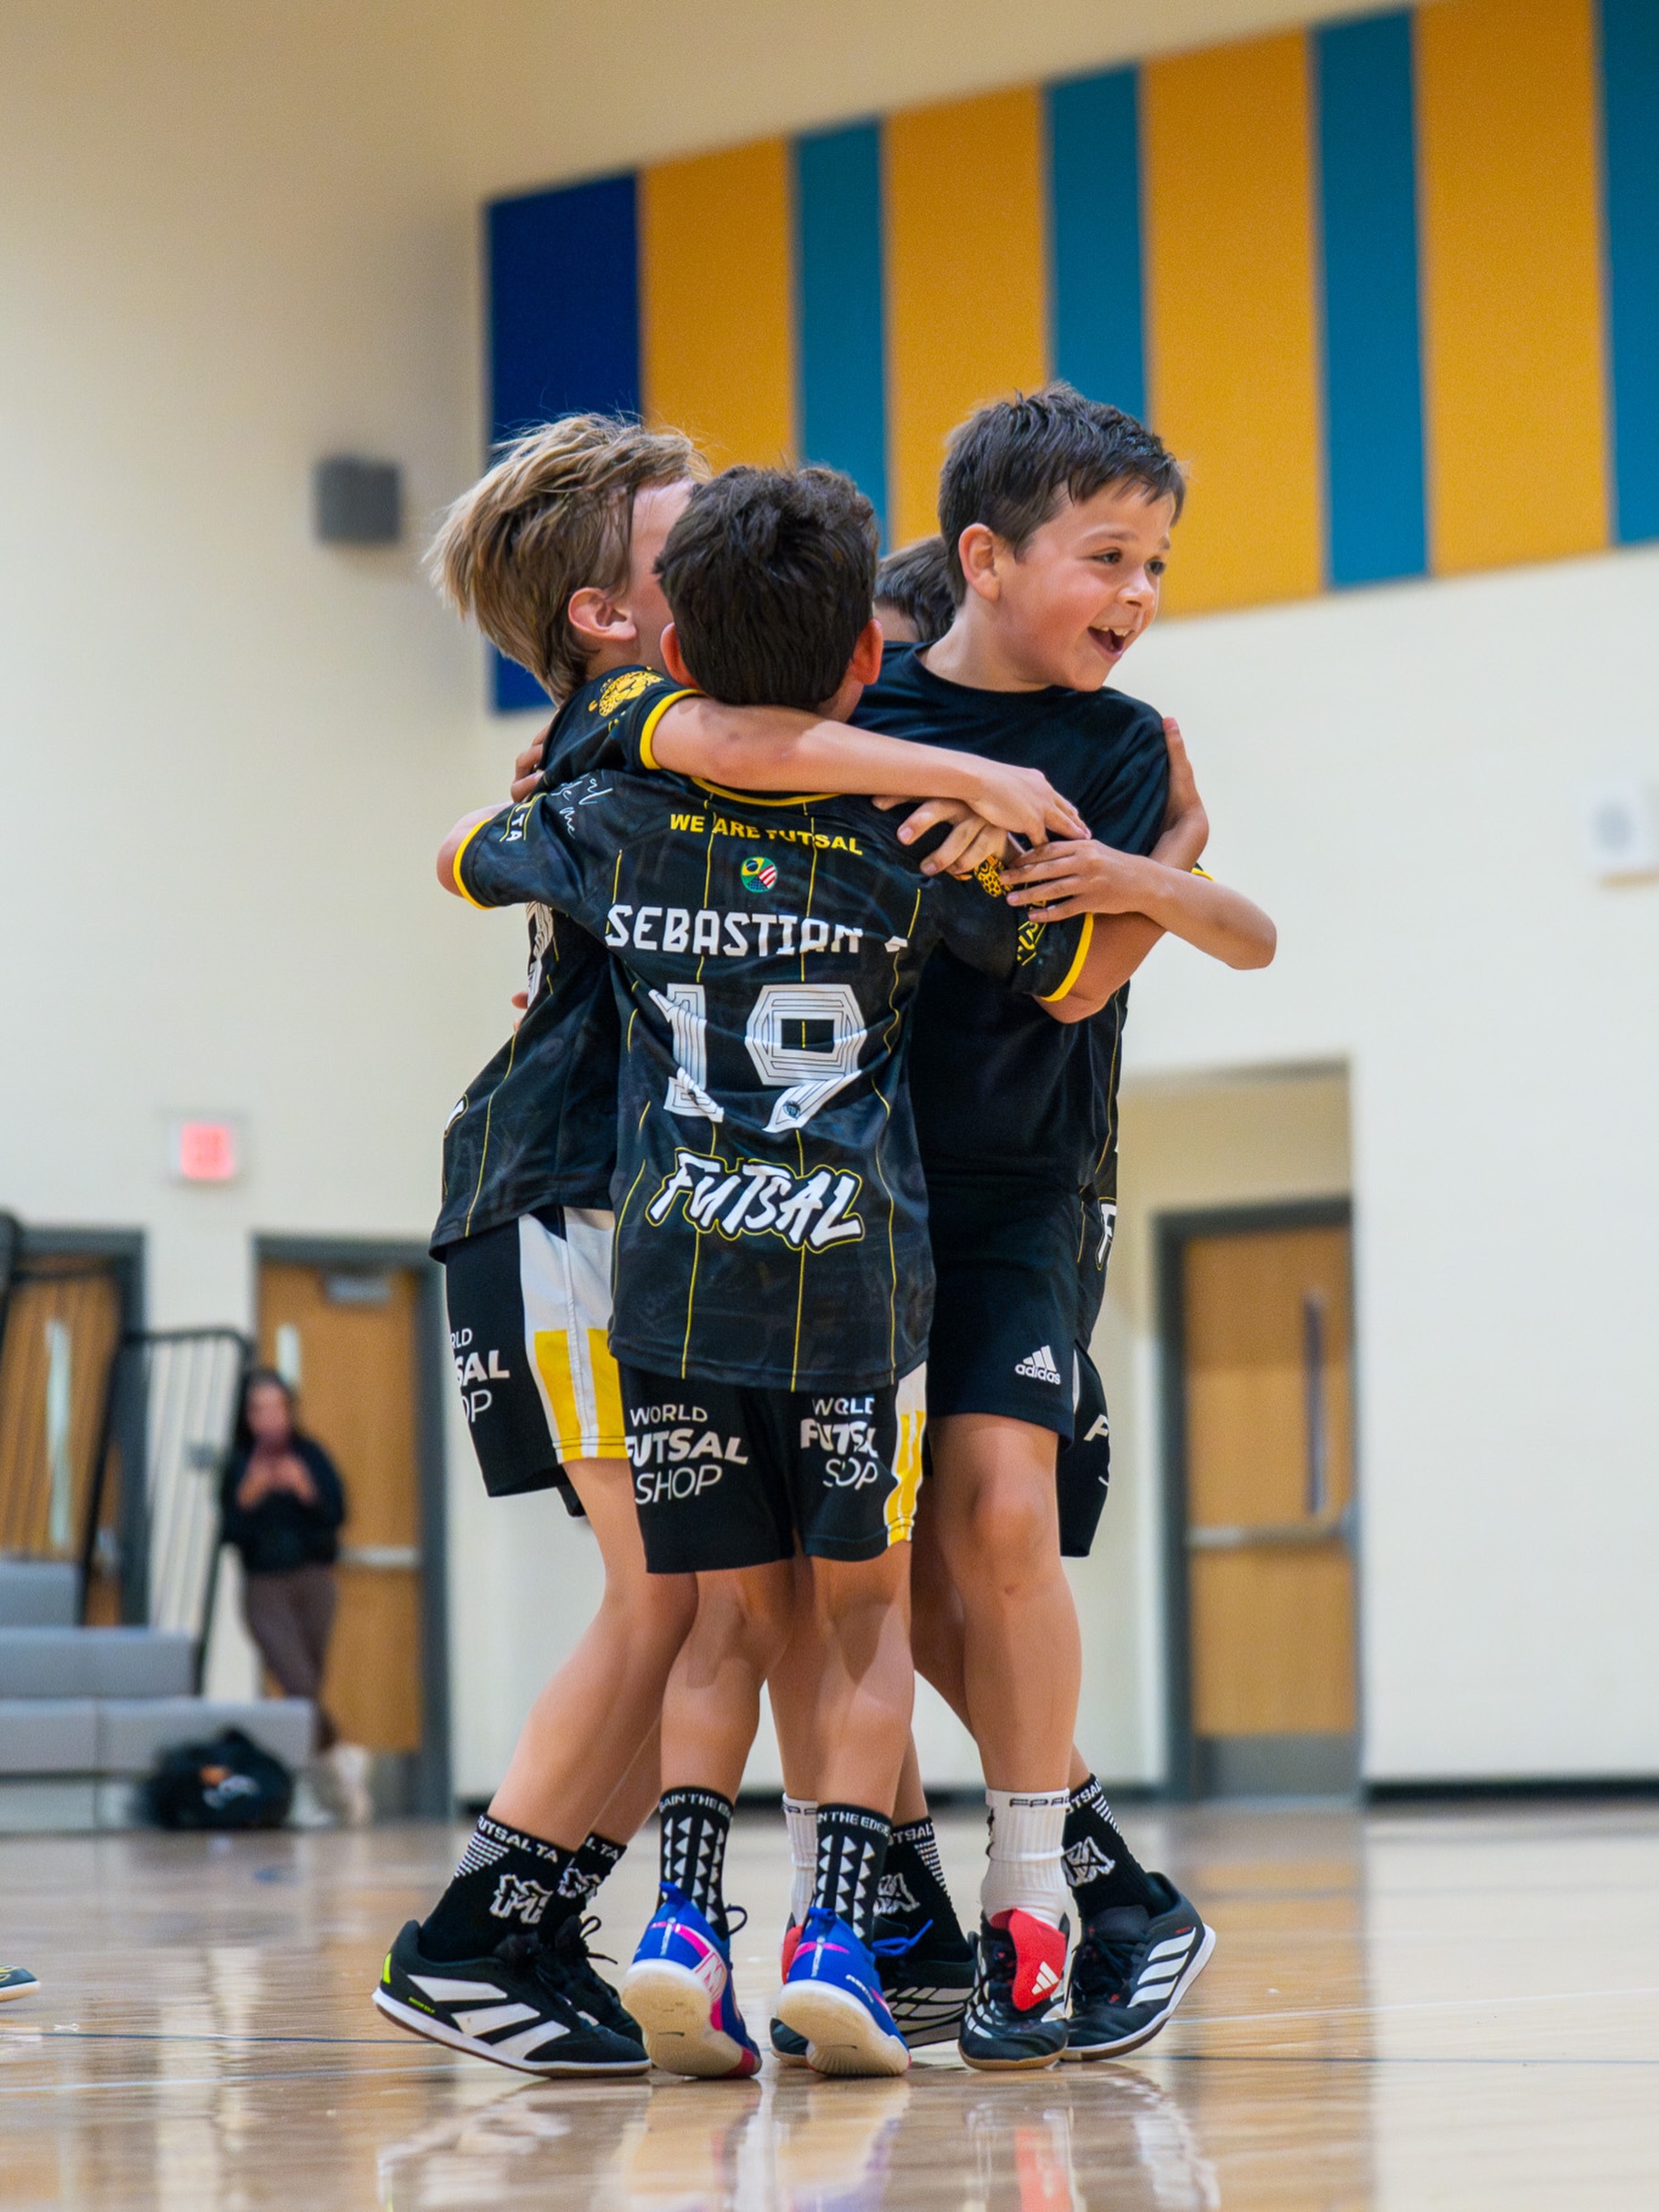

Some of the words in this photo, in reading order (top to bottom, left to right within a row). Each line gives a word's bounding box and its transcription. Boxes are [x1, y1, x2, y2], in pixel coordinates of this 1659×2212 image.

[670, 814, 706, 833] WE
[712, 818, 761, 839] ARE
[605, 904, 863, 957] SEBASTIAN
[648, 983, 868, 1133] 19
[649, 1152, 862, 1247] FUTSAL
[1015, 1363, 1061, 1385] adidas
[630, 1404, 708, 1427] WORLD
[634, 1464, 723, 1505] SHOP
[830, 1811, 859, 1826] THE
